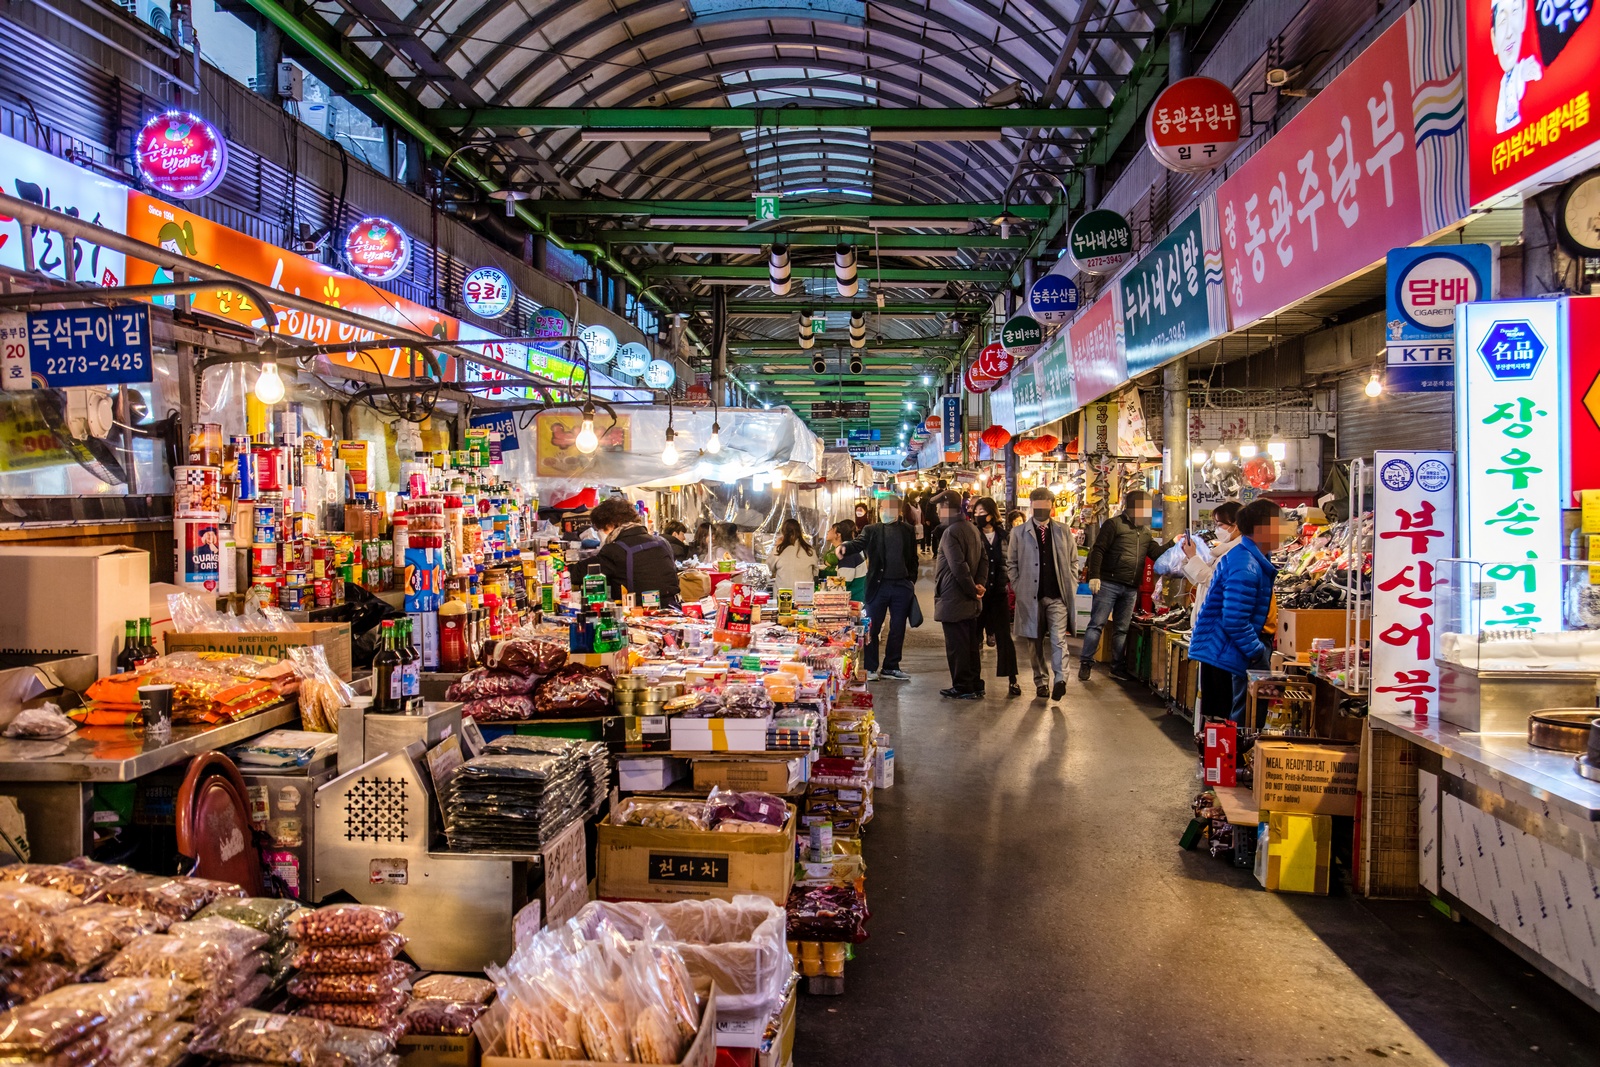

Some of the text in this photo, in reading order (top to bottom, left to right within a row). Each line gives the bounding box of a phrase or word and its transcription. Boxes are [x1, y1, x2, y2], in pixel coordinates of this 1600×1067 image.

[1155, 103, 1236, 135] 동관주단부
[1491, 91, 1590, 175] (주)부산세광식품
[1243, 80, 1405, 285] 동관주단부
[148, 204, 174, 222] Since 1994
[1073, 228, 1129, 255] 누나네신발
[1087, 254, 1123, 268] 2272-3943
[474, 270, 501, 283] 나주댁
[1125, 229, 1198, 337] 누나네신발
[467, 281, 501, 303] 육회
[1032, 288, 1077, 304] 농축수산물
[1408, 277, 1469, 307] 담배
[584, 331, 610, 347] 박가네
[5, 344, 26, 359] 20
[622, 347, 645, 361] 박가네
[985, 349, 1008, 361] 广场
[1492, 341, 1533, 361] 名品
[46, 352, 144, 375] 2273-2425
[986, 360, 1009, 373] 人参
[9, 365, 25, 379] 호
[1421, 462, 1446, 472] HACCP
[1481, 397, 1547, 633] 장우손어묵
[200, 562, 218, 570] OATS
[1375, 500, 1450, 715] 부산어묵
[1265, 757, 1284, 770] MEAL,
[1265, 771, 1284, 780] (Repas,
[1264, 781, 1272, 789] DO
[1273, 782, 1283, 790] NOT
[1284, 783, 1301, 792] ROUGH
[1302, 785, 1322, 793] HANDLE
[1323, 786, 1338, 794] WHEN
[1283, 795, 1300, 804] below)
